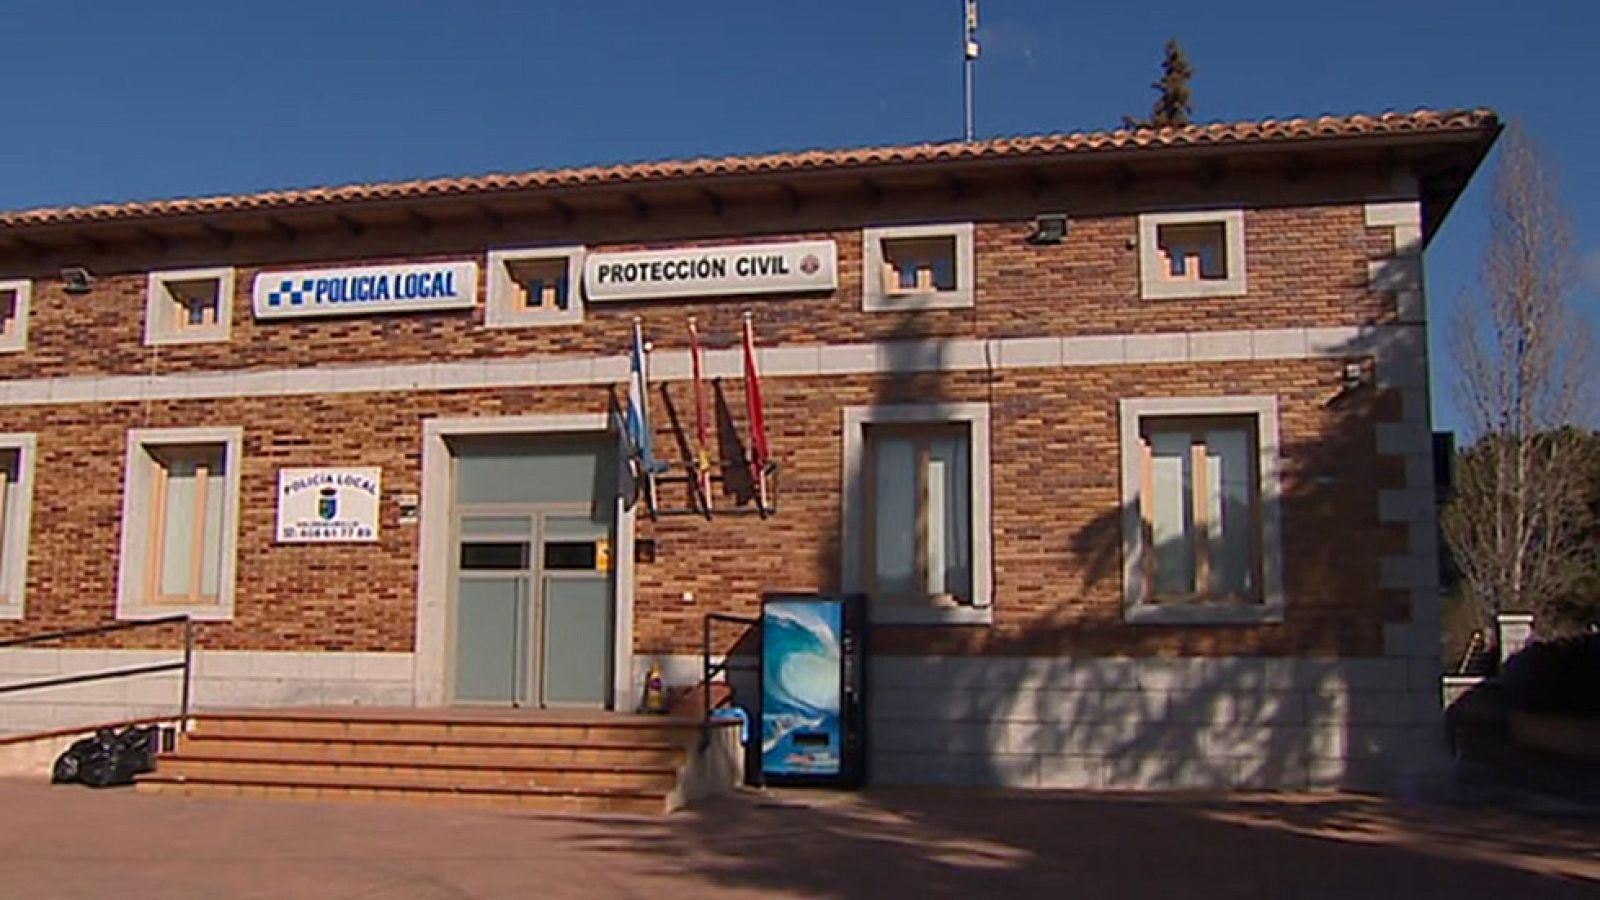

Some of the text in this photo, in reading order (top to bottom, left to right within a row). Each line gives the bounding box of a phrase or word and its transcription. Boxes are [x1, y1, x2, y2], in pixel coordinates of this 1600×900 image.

[598, 255, 789, 284] PROTECCIÓN CIVIL
[316, 270, 456, 304] POLICIA LOCAL
[336, 473, 376, 496] LOCAL
